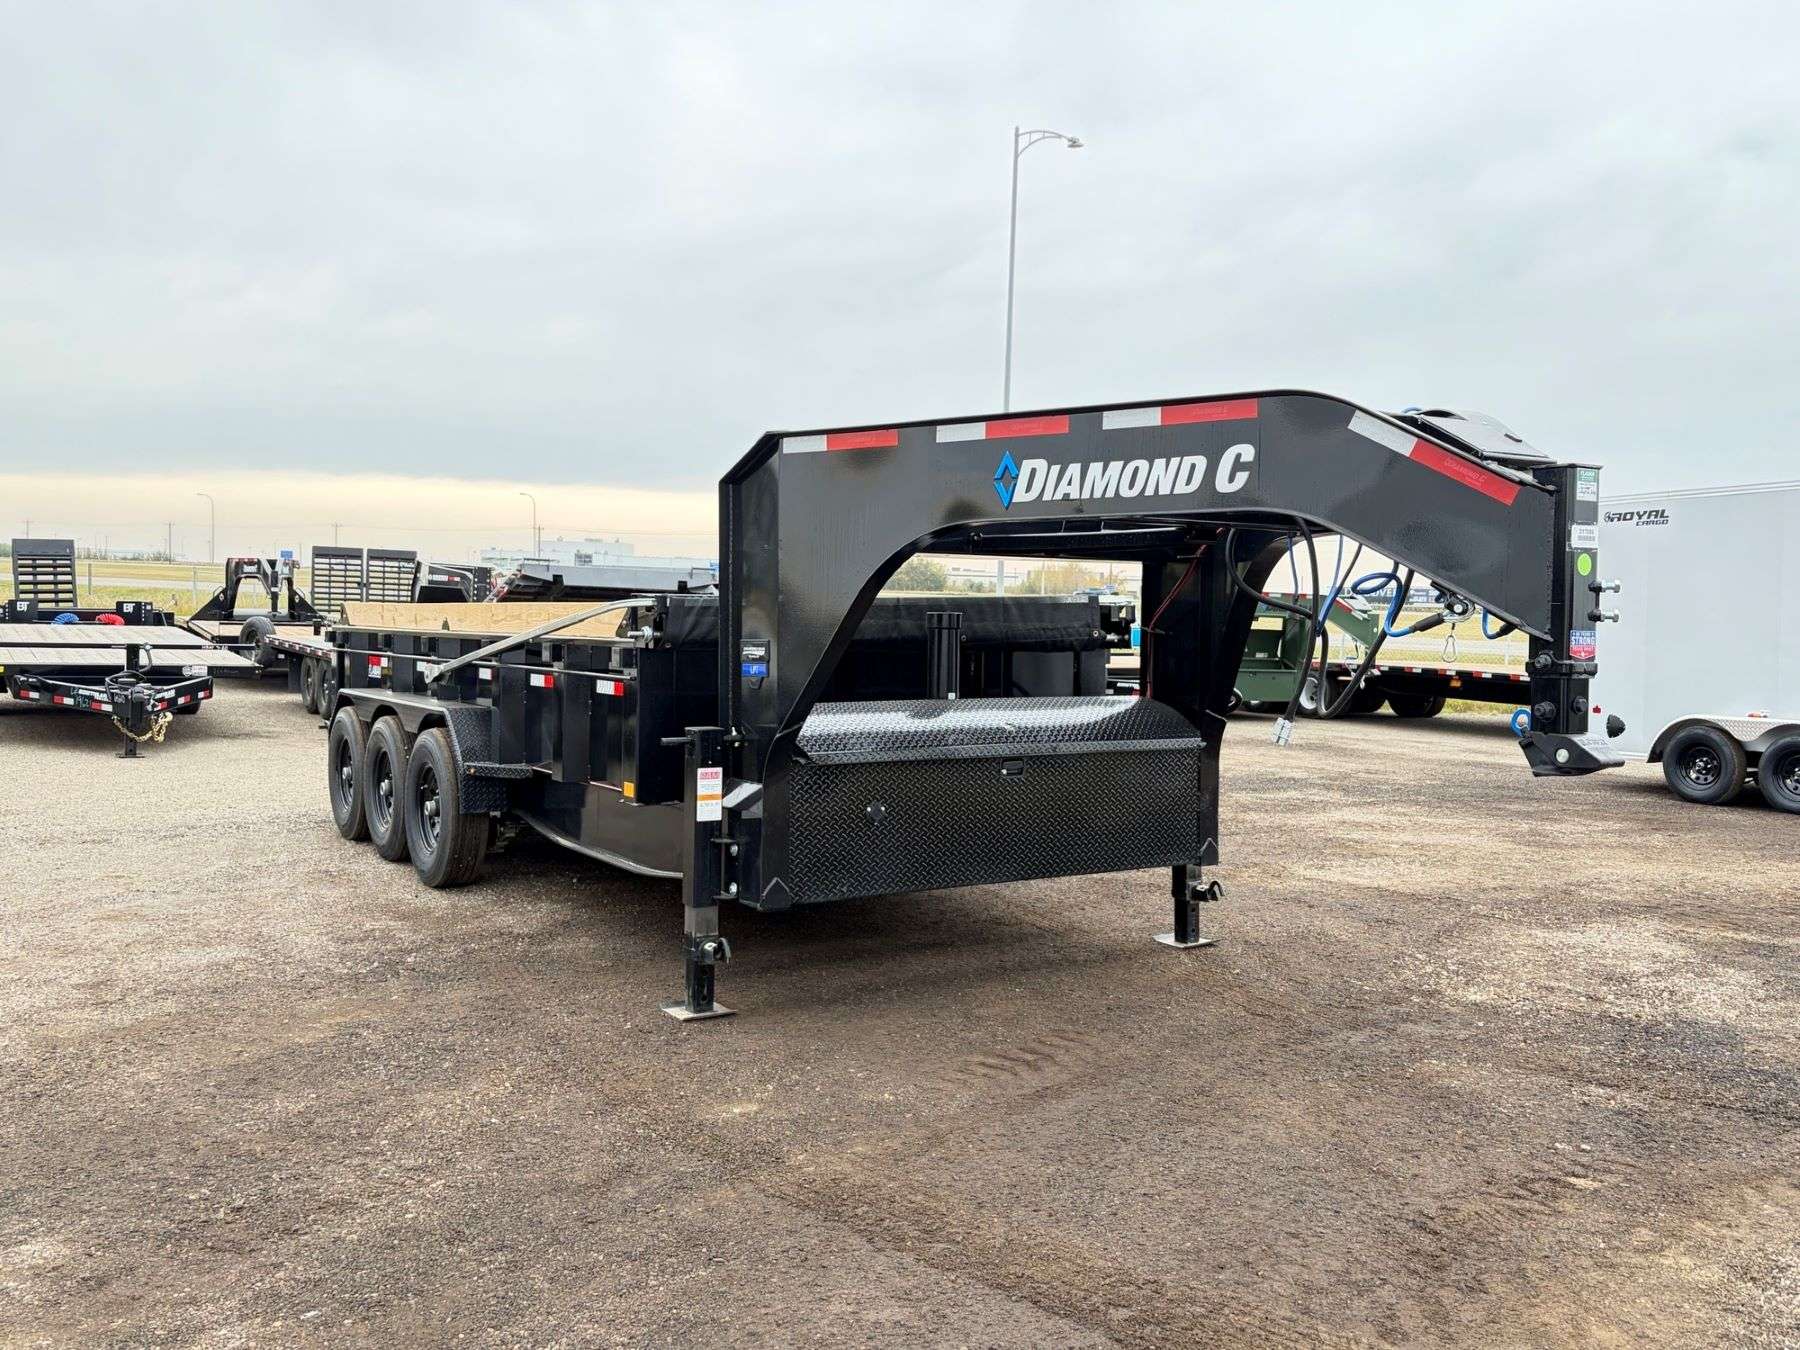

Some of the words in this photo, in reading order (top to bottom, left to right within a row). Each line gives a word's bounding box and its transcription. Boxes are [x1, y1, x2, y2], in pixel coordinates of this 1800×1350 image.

[1011, 454, 1208, 503] DIAMOND
[1215, 443, 1256, 494] C
[1610, 509, 1669, 522] ROYAL
[1636, 519, 1669, 527] CARGO
[16, 601, 30, 612] BT
[122, 603, 136, 613] BT
[1571, 636, 1596, 646] STRONG
